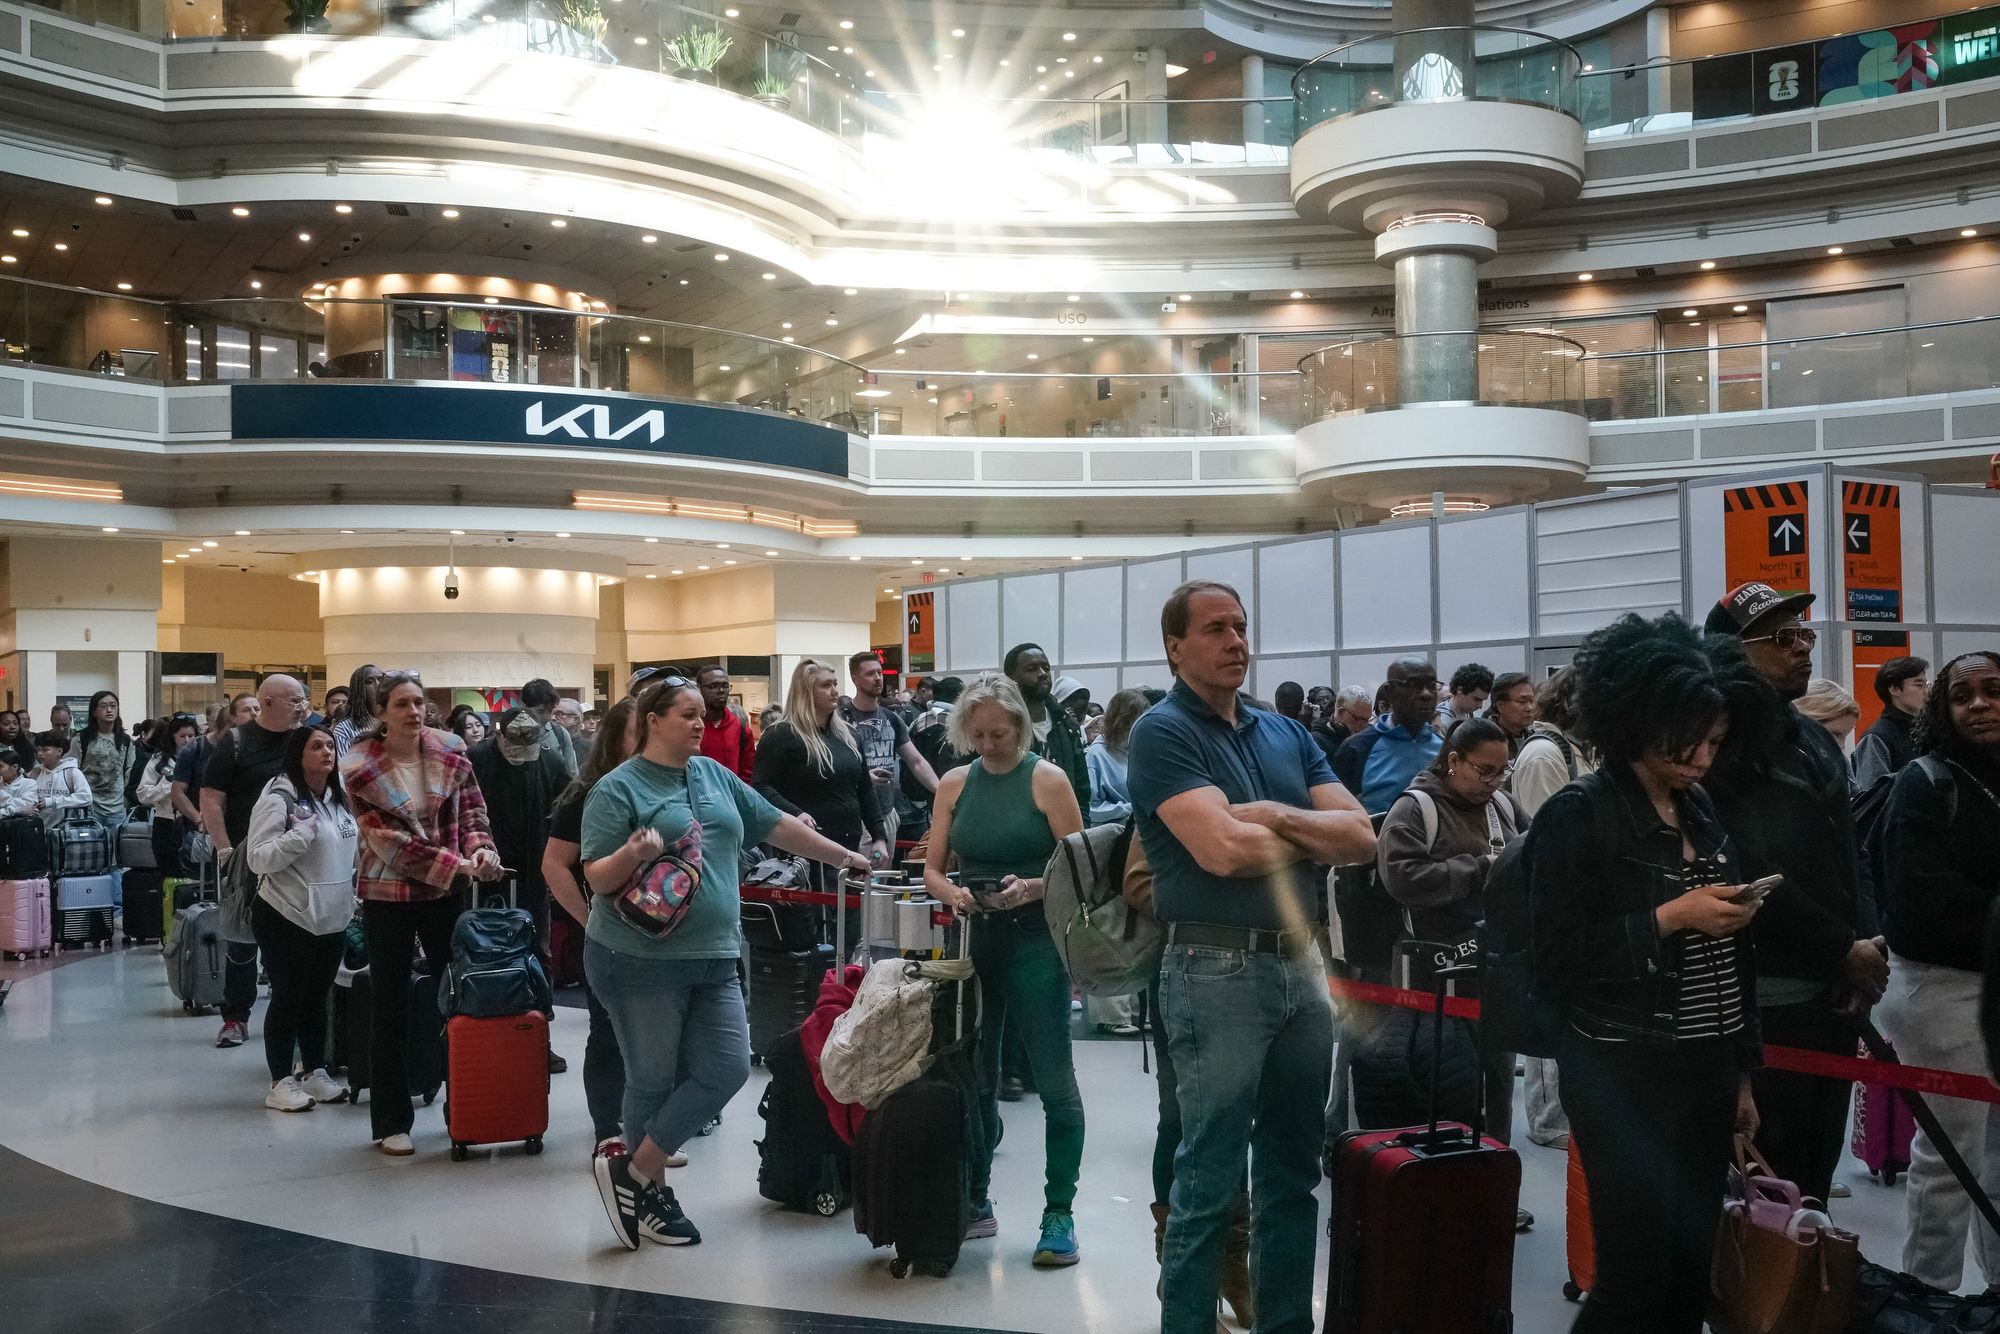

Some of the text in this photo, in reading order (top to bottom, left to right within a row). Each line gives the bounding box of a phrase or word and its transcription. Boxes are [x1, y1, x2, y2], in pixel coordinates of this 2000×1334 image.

[1371, 299, 1530, 318] Airp elations
[1057, 312, 1087, 324] USO
[526, 401, 665, 444] KIA
[1760, 561, 1788, 572] North
[1858, 560, 1878, 570] South
[1733, 576, 1788, 591] Chpoint
[1855, 593, 1865, 601] TSA
[1855, 610, 1871, 618] CLEAR
[771, 890, 782, 899] ATL
